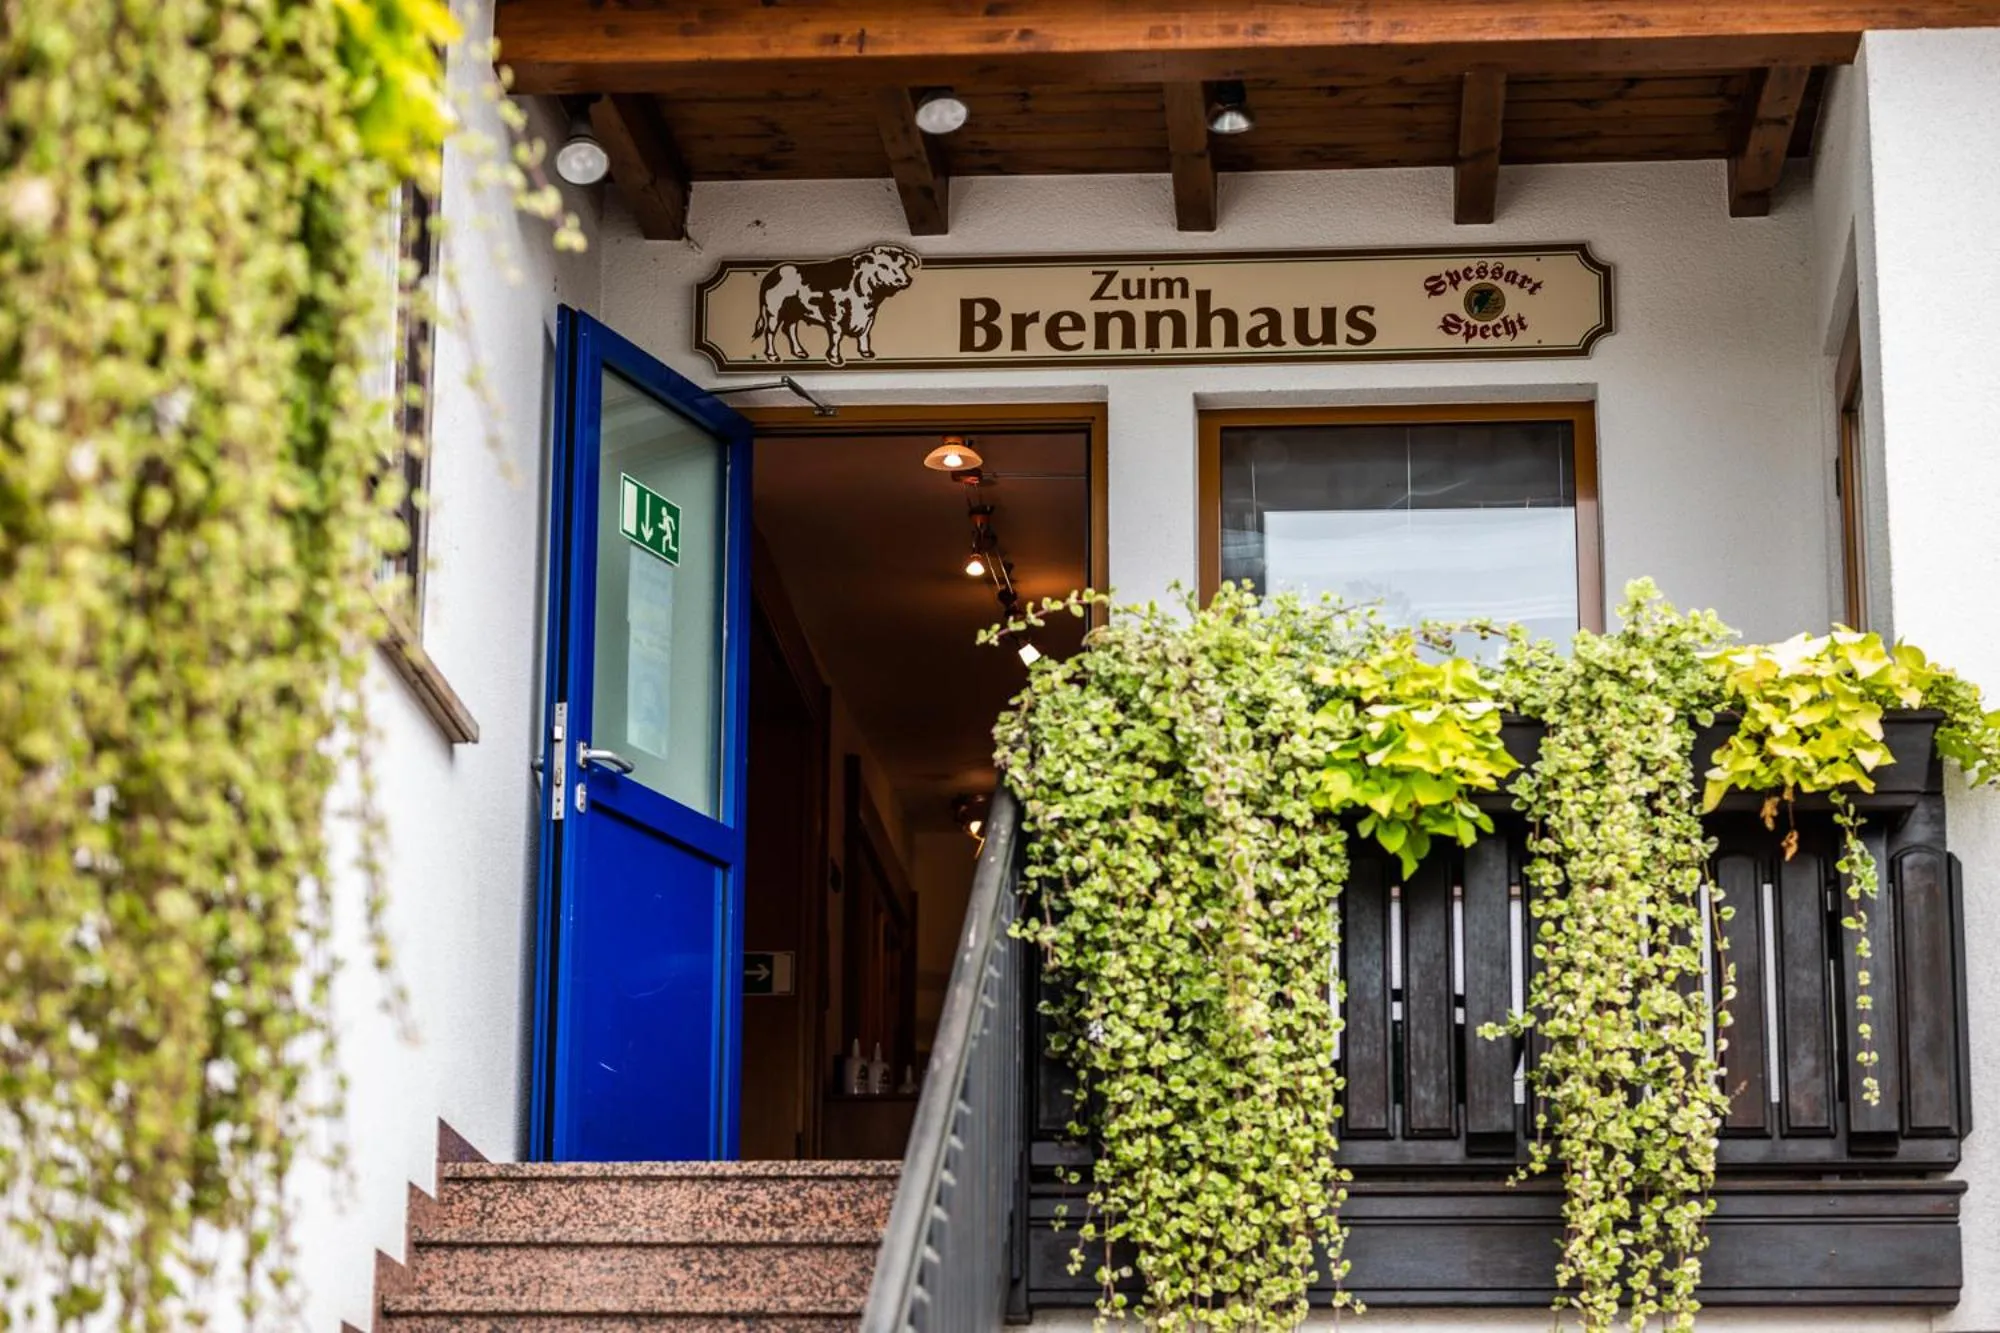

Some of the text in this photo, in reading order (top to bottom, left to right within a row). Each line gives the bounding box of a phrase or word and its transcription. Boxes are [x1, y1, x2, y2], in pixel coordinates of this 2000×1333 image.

[1090, 270, 1190, 301] Zum
[1424, 261, 1544, 298] Spessart
[959, 289, 1377, 352] Brennhaus
[1438, 313, 1528, 343] Specht
